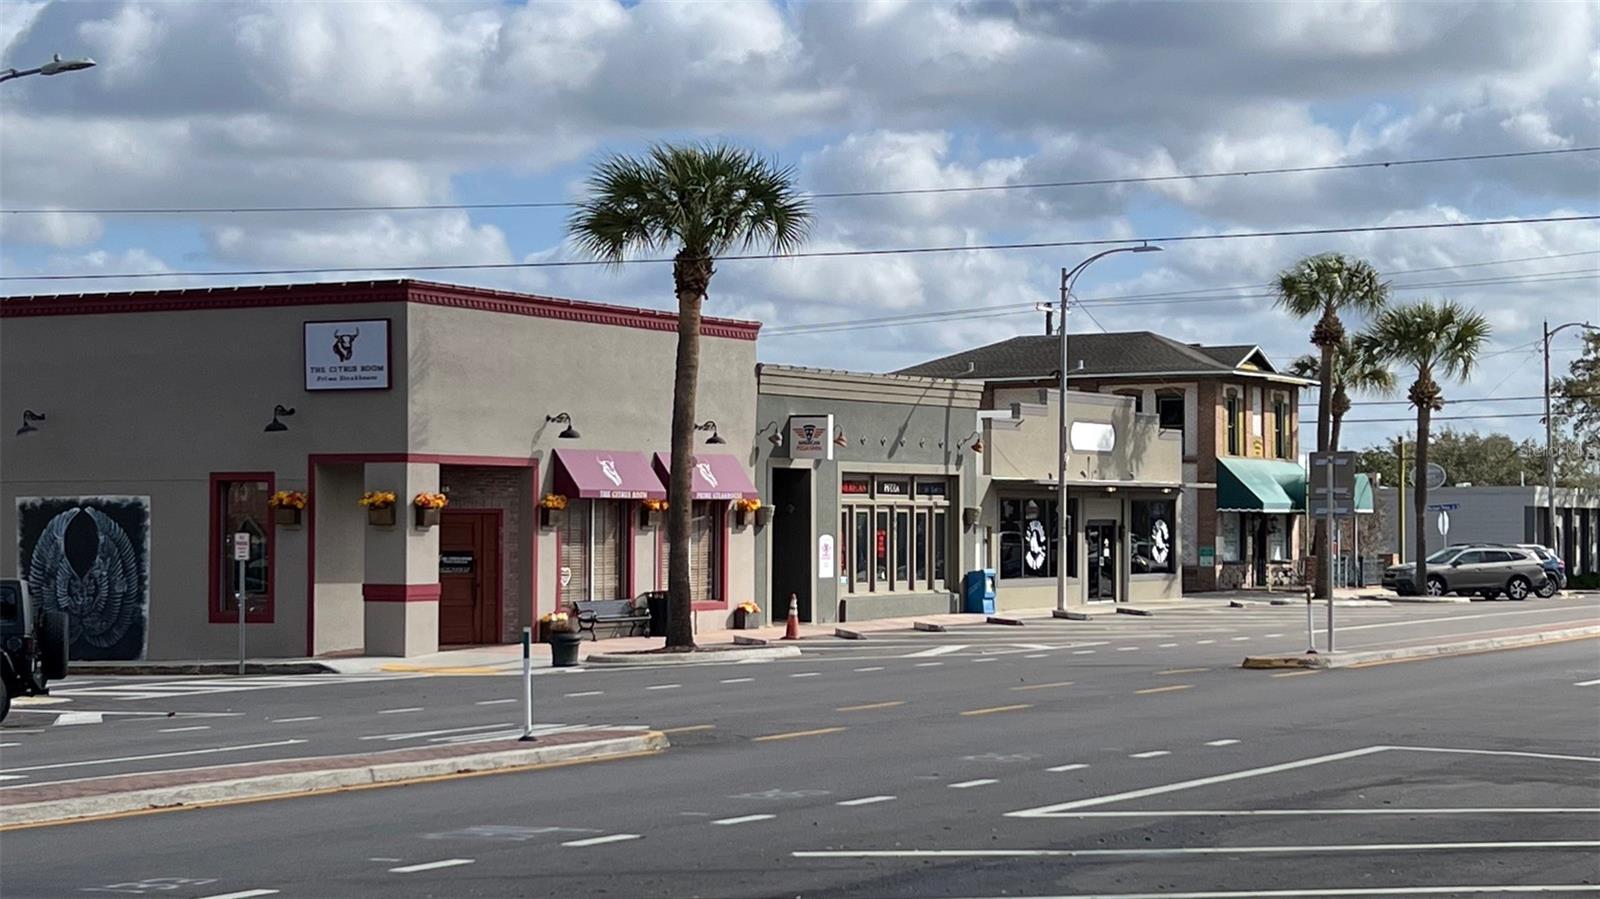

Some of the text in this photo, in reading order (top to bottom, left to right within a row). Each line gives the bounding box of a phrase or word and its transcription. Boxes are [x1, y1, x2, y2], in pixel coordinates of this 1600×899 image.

[310, 364, 384, 374] THE CITRUS ROOM
